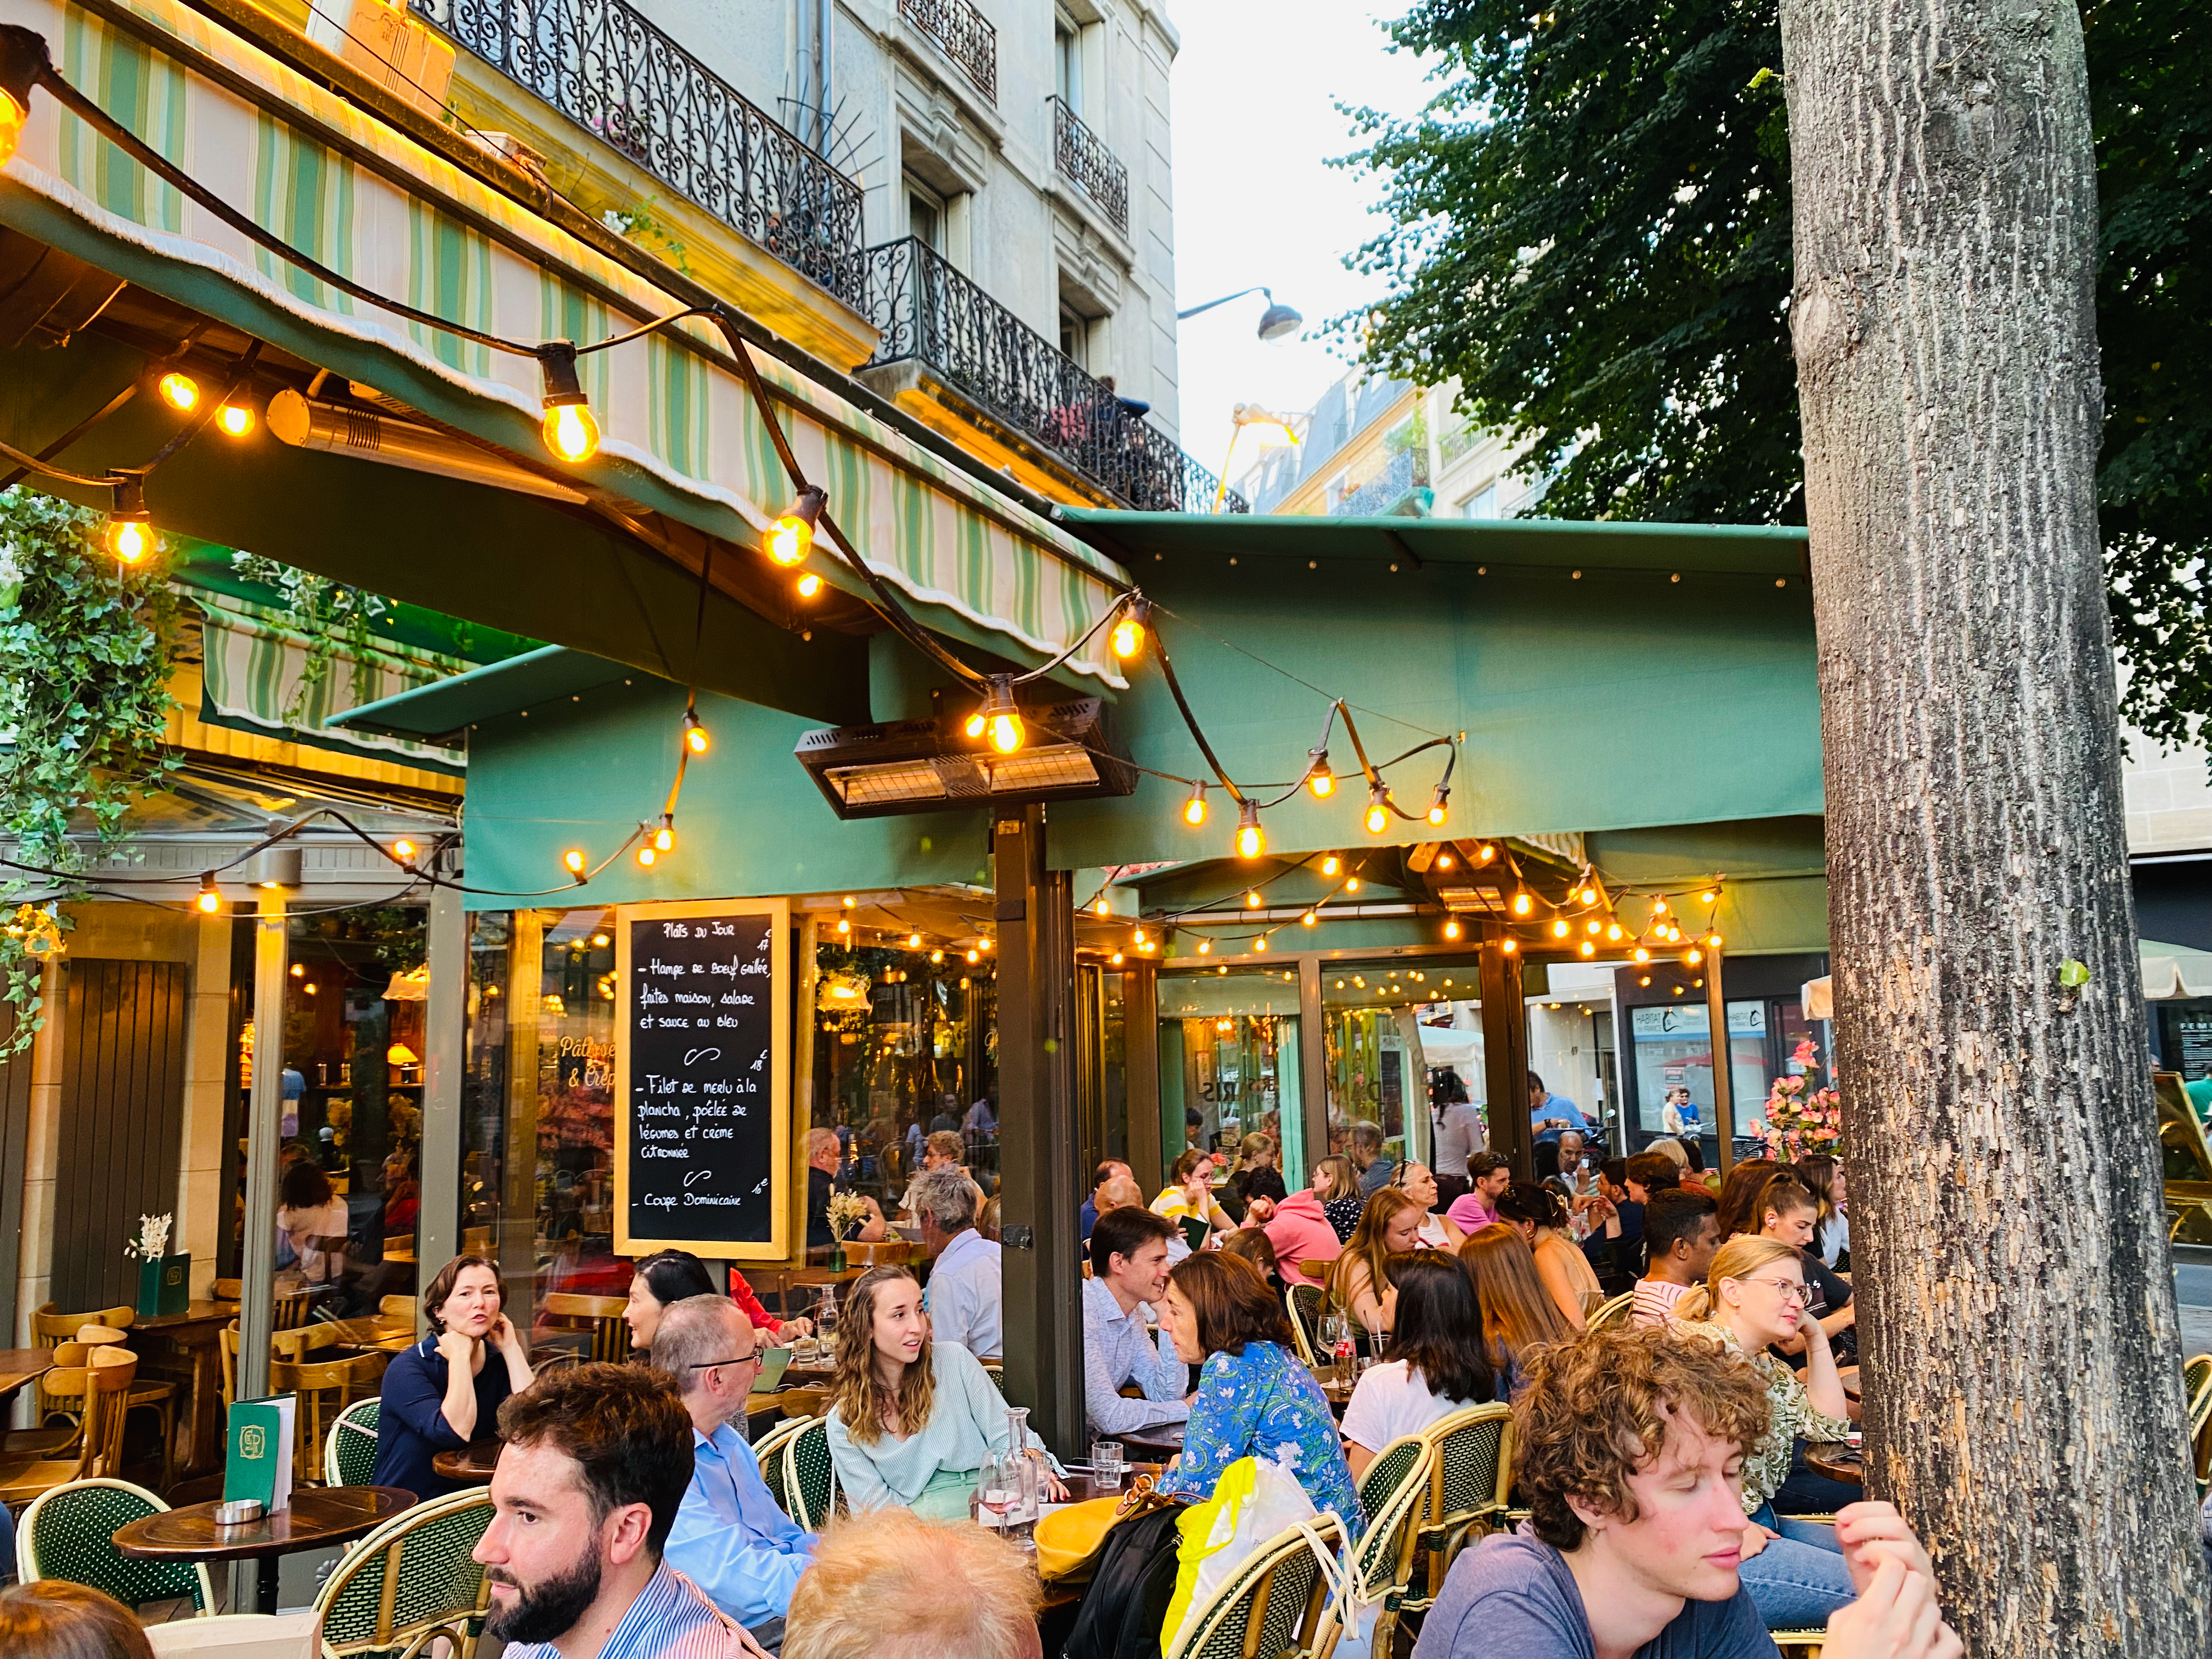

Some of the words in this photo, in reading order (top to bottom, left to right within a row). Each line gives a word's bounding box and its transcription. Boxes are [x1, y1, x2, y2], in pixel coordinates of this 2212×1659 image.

[663, 922, 688, 938] Plats
[650, 958, 685, 980] Hampe
[720, 989, 755, 1005] salade
[697, 1018, 709, 1028] au
[1636, 1013, 1661, 1024] HABITAT
[646, 1075, 679, 1093] Filet
[639, 1124, 679, 1139] légumes
[644, 1194, 678, 1212] Coupe
[683, 1193, 741, 1206] Dominicaine
